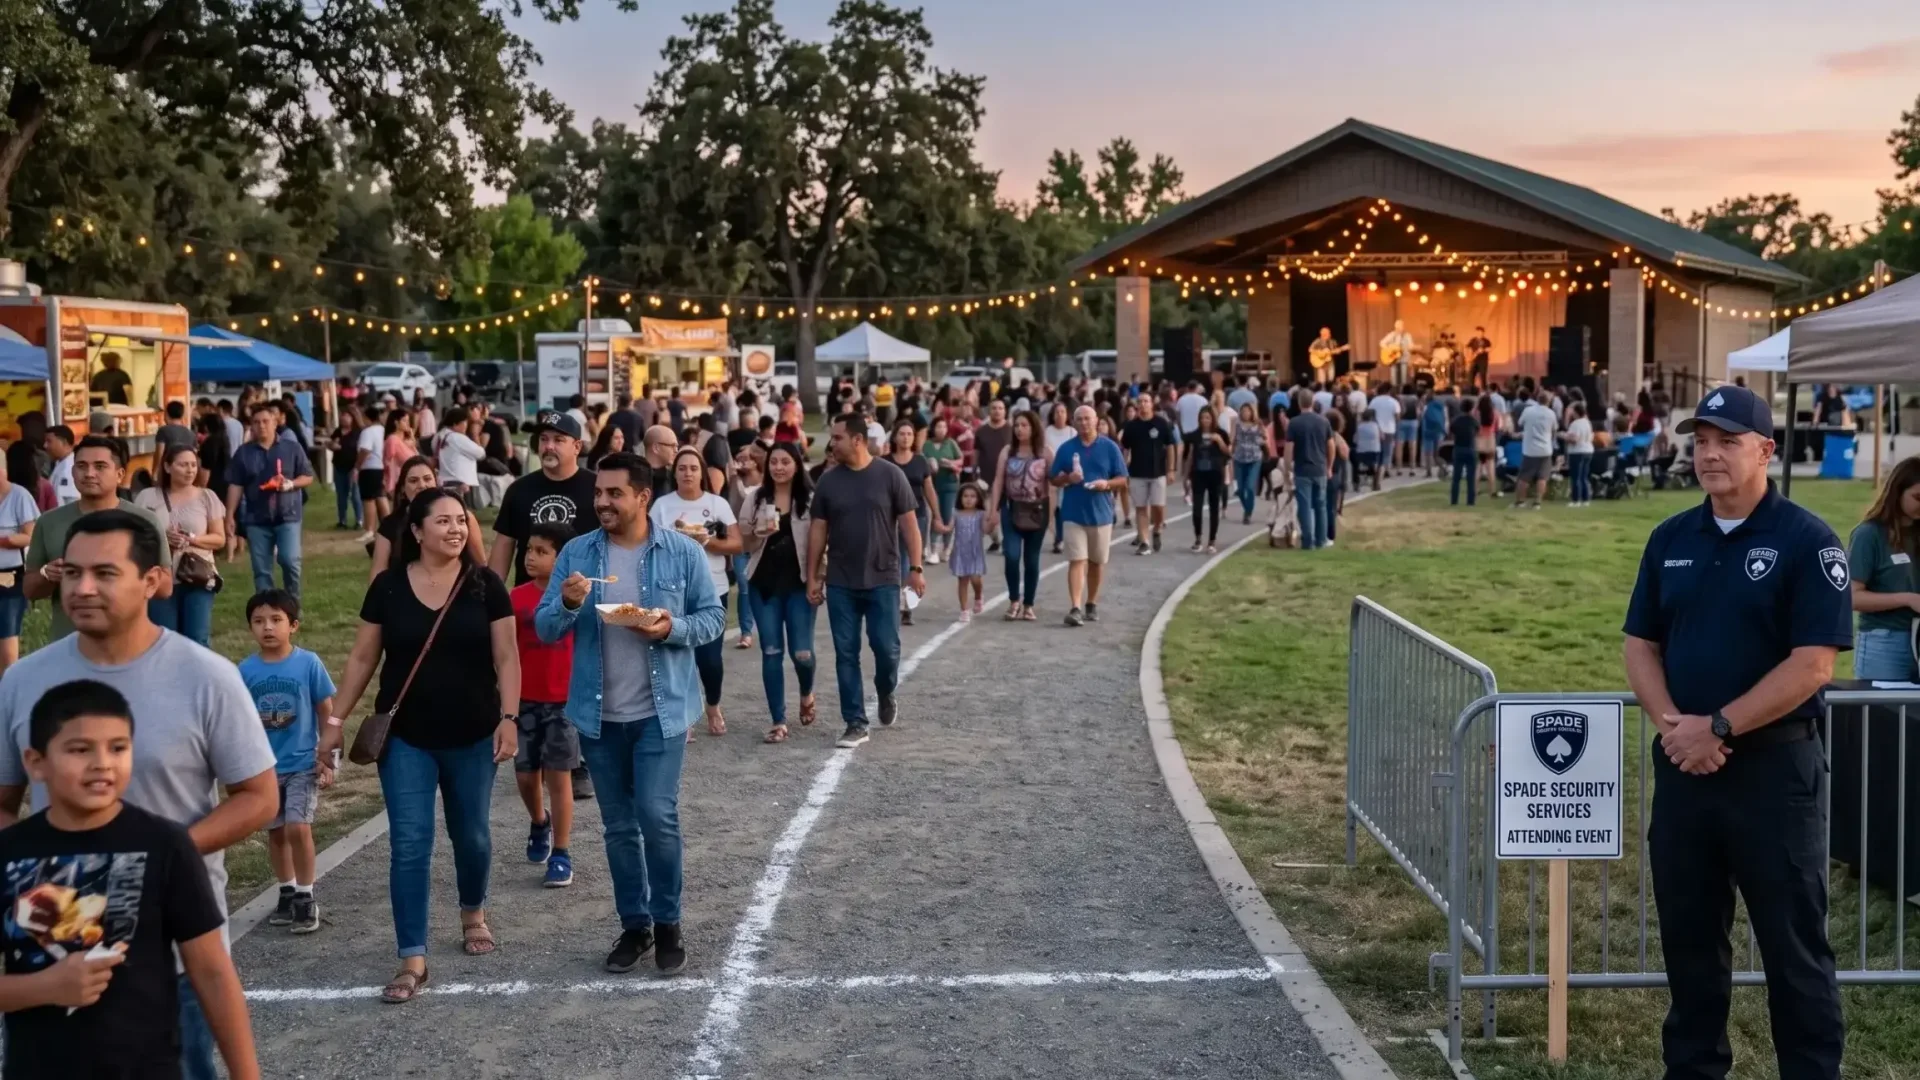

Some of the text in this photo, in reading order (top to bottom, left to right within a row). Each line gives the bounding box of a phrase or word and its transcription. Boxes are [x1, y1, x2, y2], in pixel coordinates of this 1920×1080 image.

[1536, 716, 1583, 729] SPADE
[1504, 782, 1616, 798] SPADE SECURITY
[1527, 803, 1592, 819] SERVICES
[1507, 829, 1612, 844] ATTENDING EVENT
